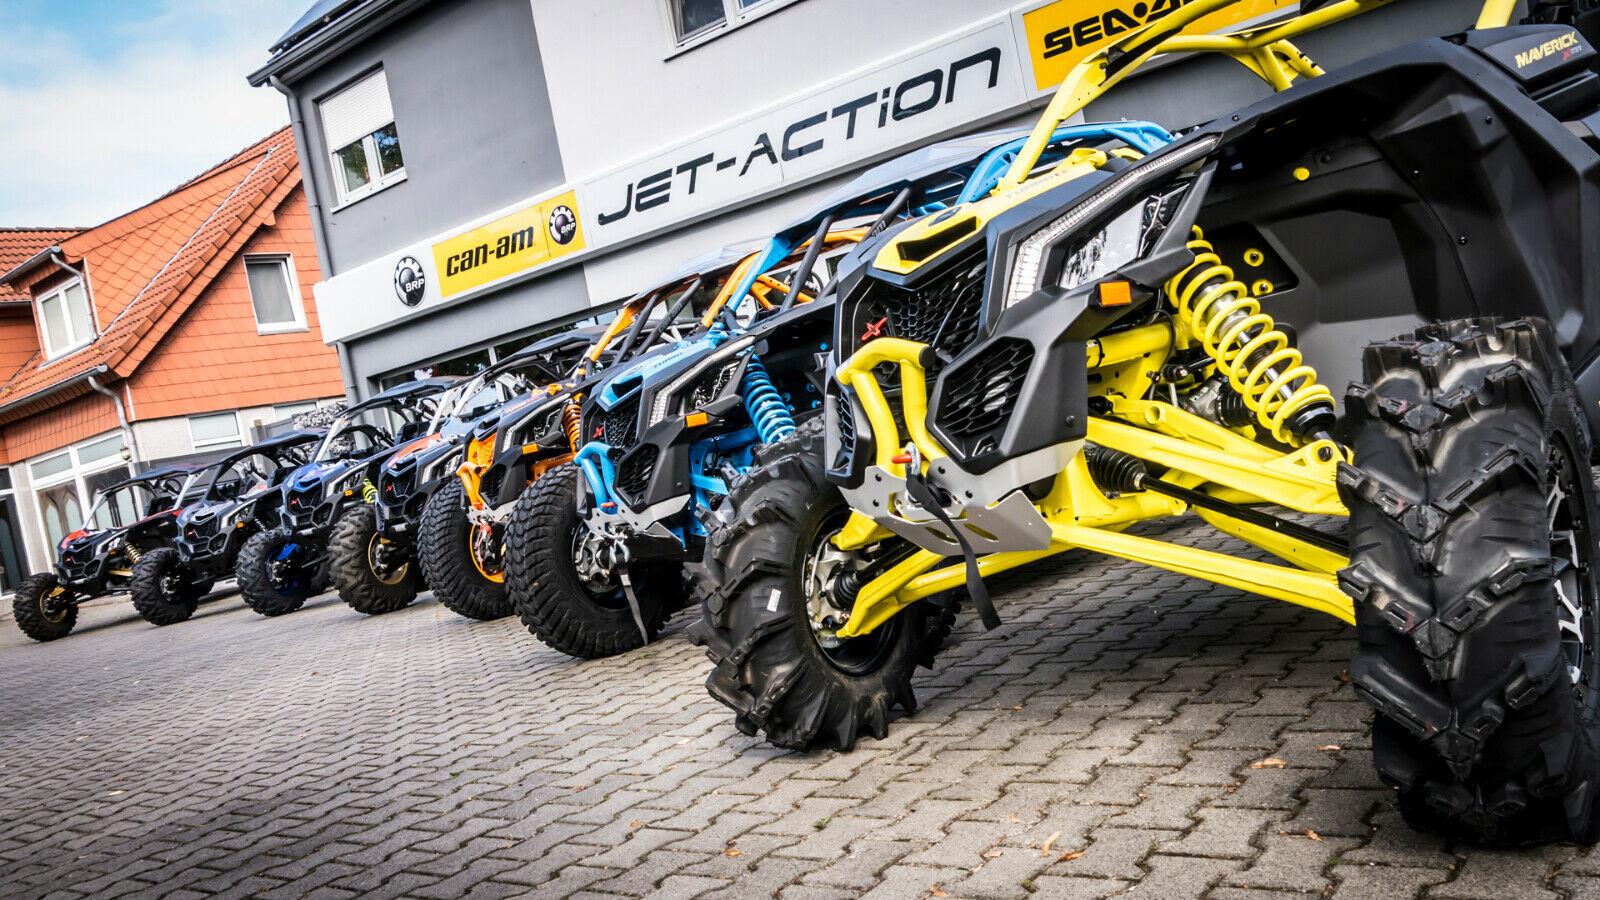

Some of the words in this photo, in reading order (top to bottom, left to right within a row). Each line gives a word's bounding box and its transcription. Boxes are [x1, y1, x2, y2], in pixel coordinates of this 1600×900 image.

[1514, 31, 1578, 69] MAVERICK
[561, 222, 576, 233] BRP
[446, 226, 534, 277] can-am
[405, 278, 425, 293] BRP
